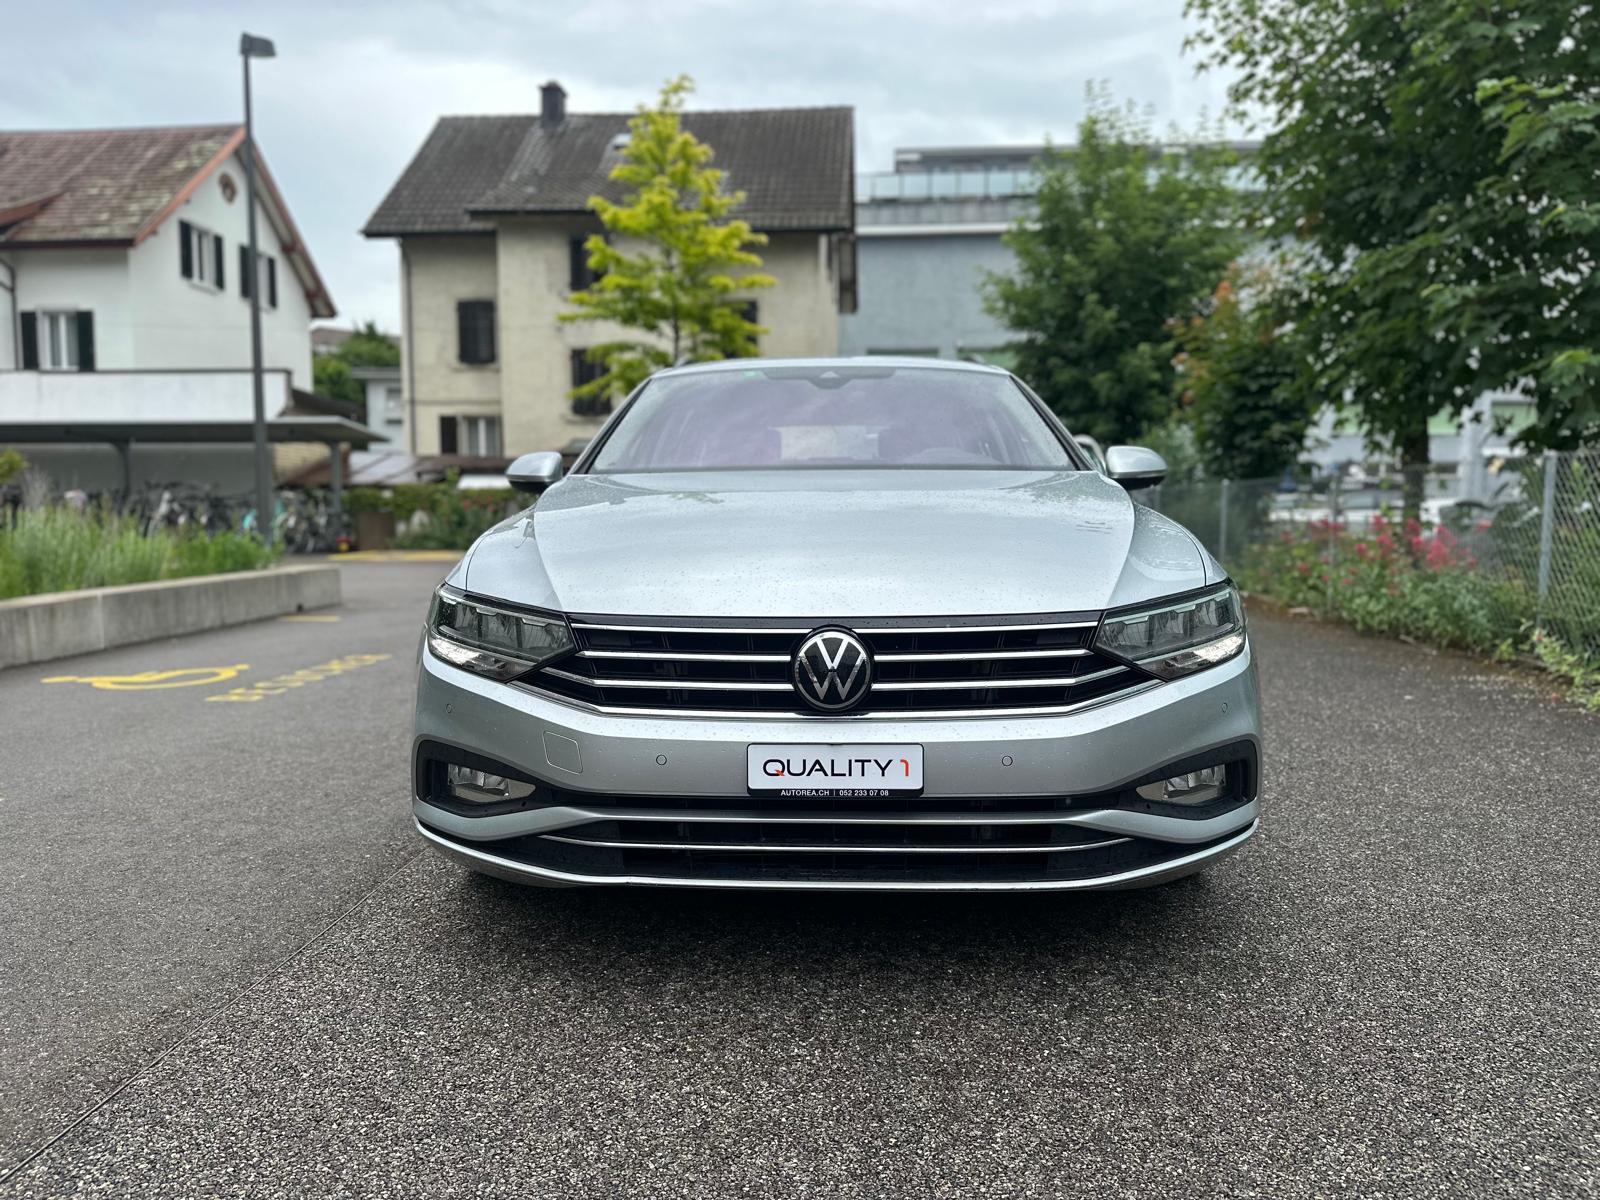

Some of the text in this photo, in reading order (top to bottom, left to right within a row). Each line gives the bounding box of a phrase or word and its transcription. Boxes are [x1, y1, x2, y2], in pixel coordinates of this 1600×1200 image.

[798, 636, 867, 701] VW
[762, 758, 910, 778] QUALITY 1
[780, 789, 889, 797] AUTOREA.CH 052 233 07 08
